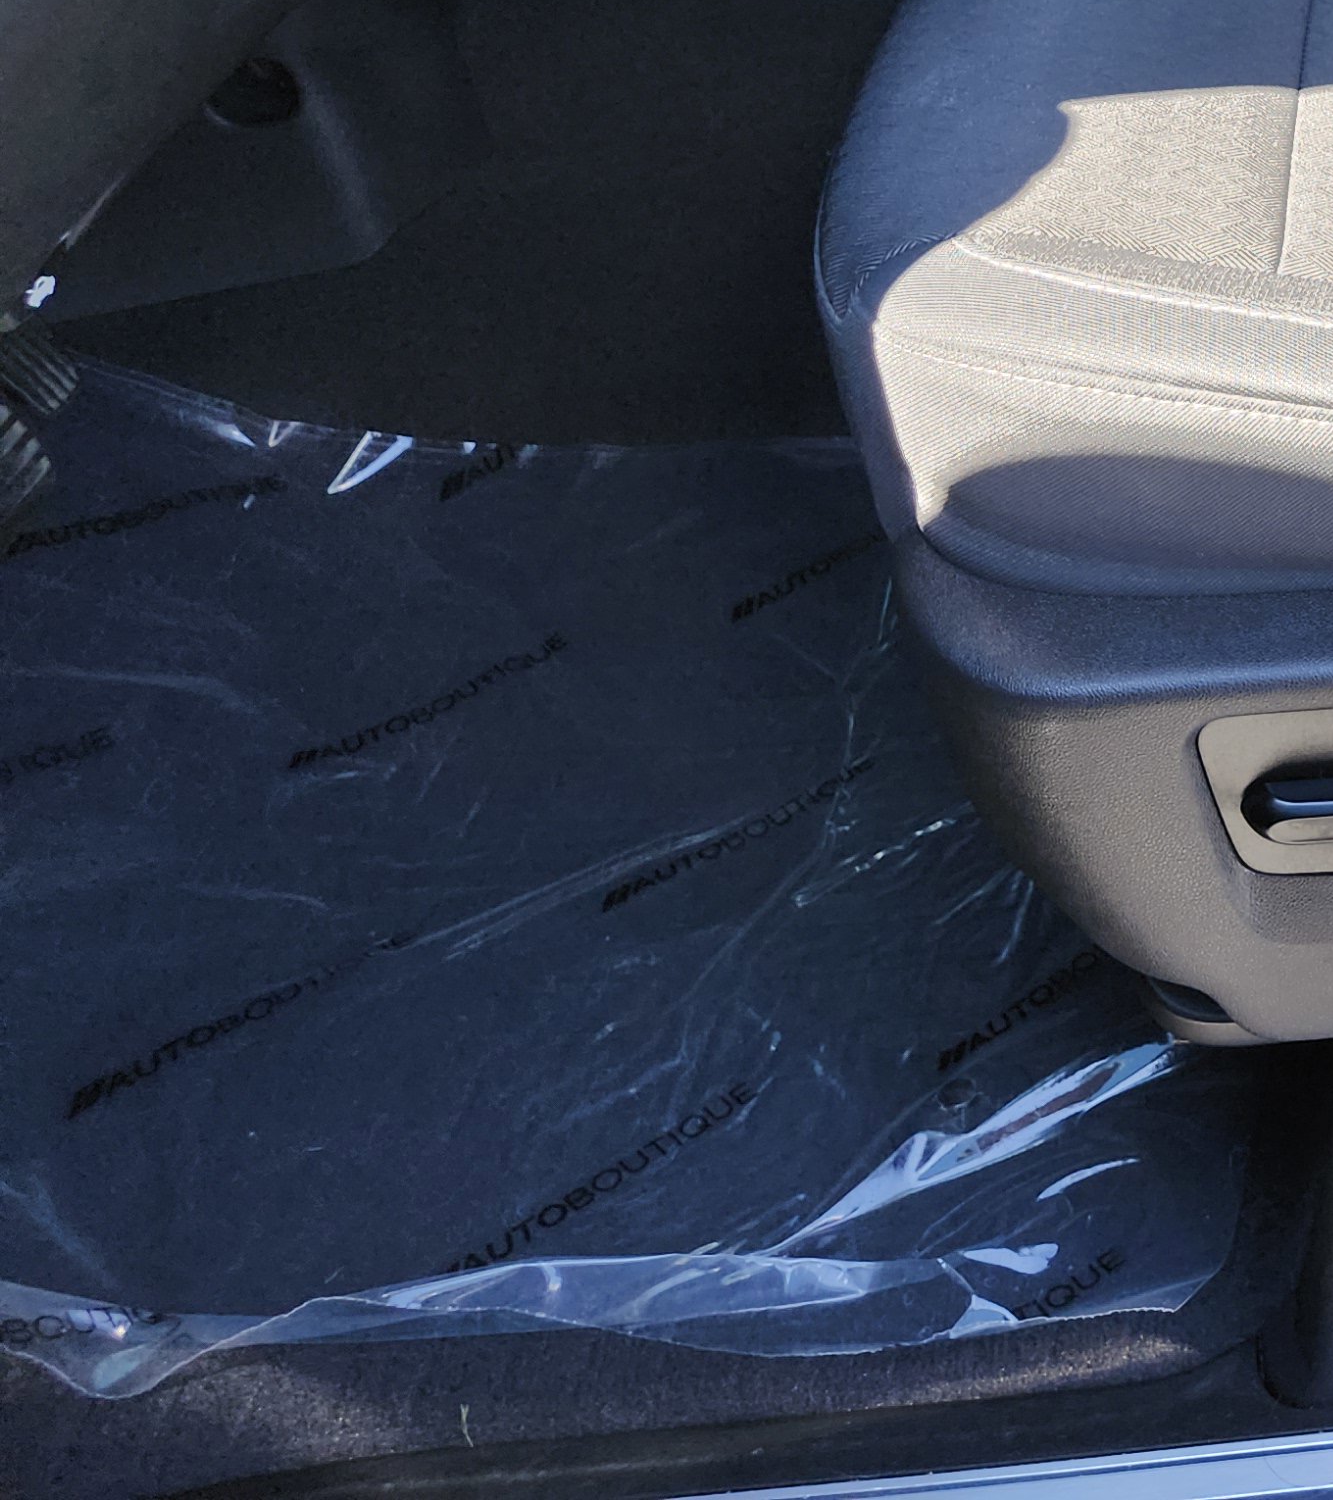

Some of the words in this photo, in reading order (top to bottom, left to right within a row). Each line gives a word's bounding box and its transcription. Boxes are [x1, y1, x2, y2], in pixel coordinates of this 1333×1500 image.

[310, 630, 567, 764] AUTOBOUTIQUE
[630, 757, 877, 891] AUTOBOUTIQUE
[460, 1080, 759, 1273] AUTOBOUTIQUE
